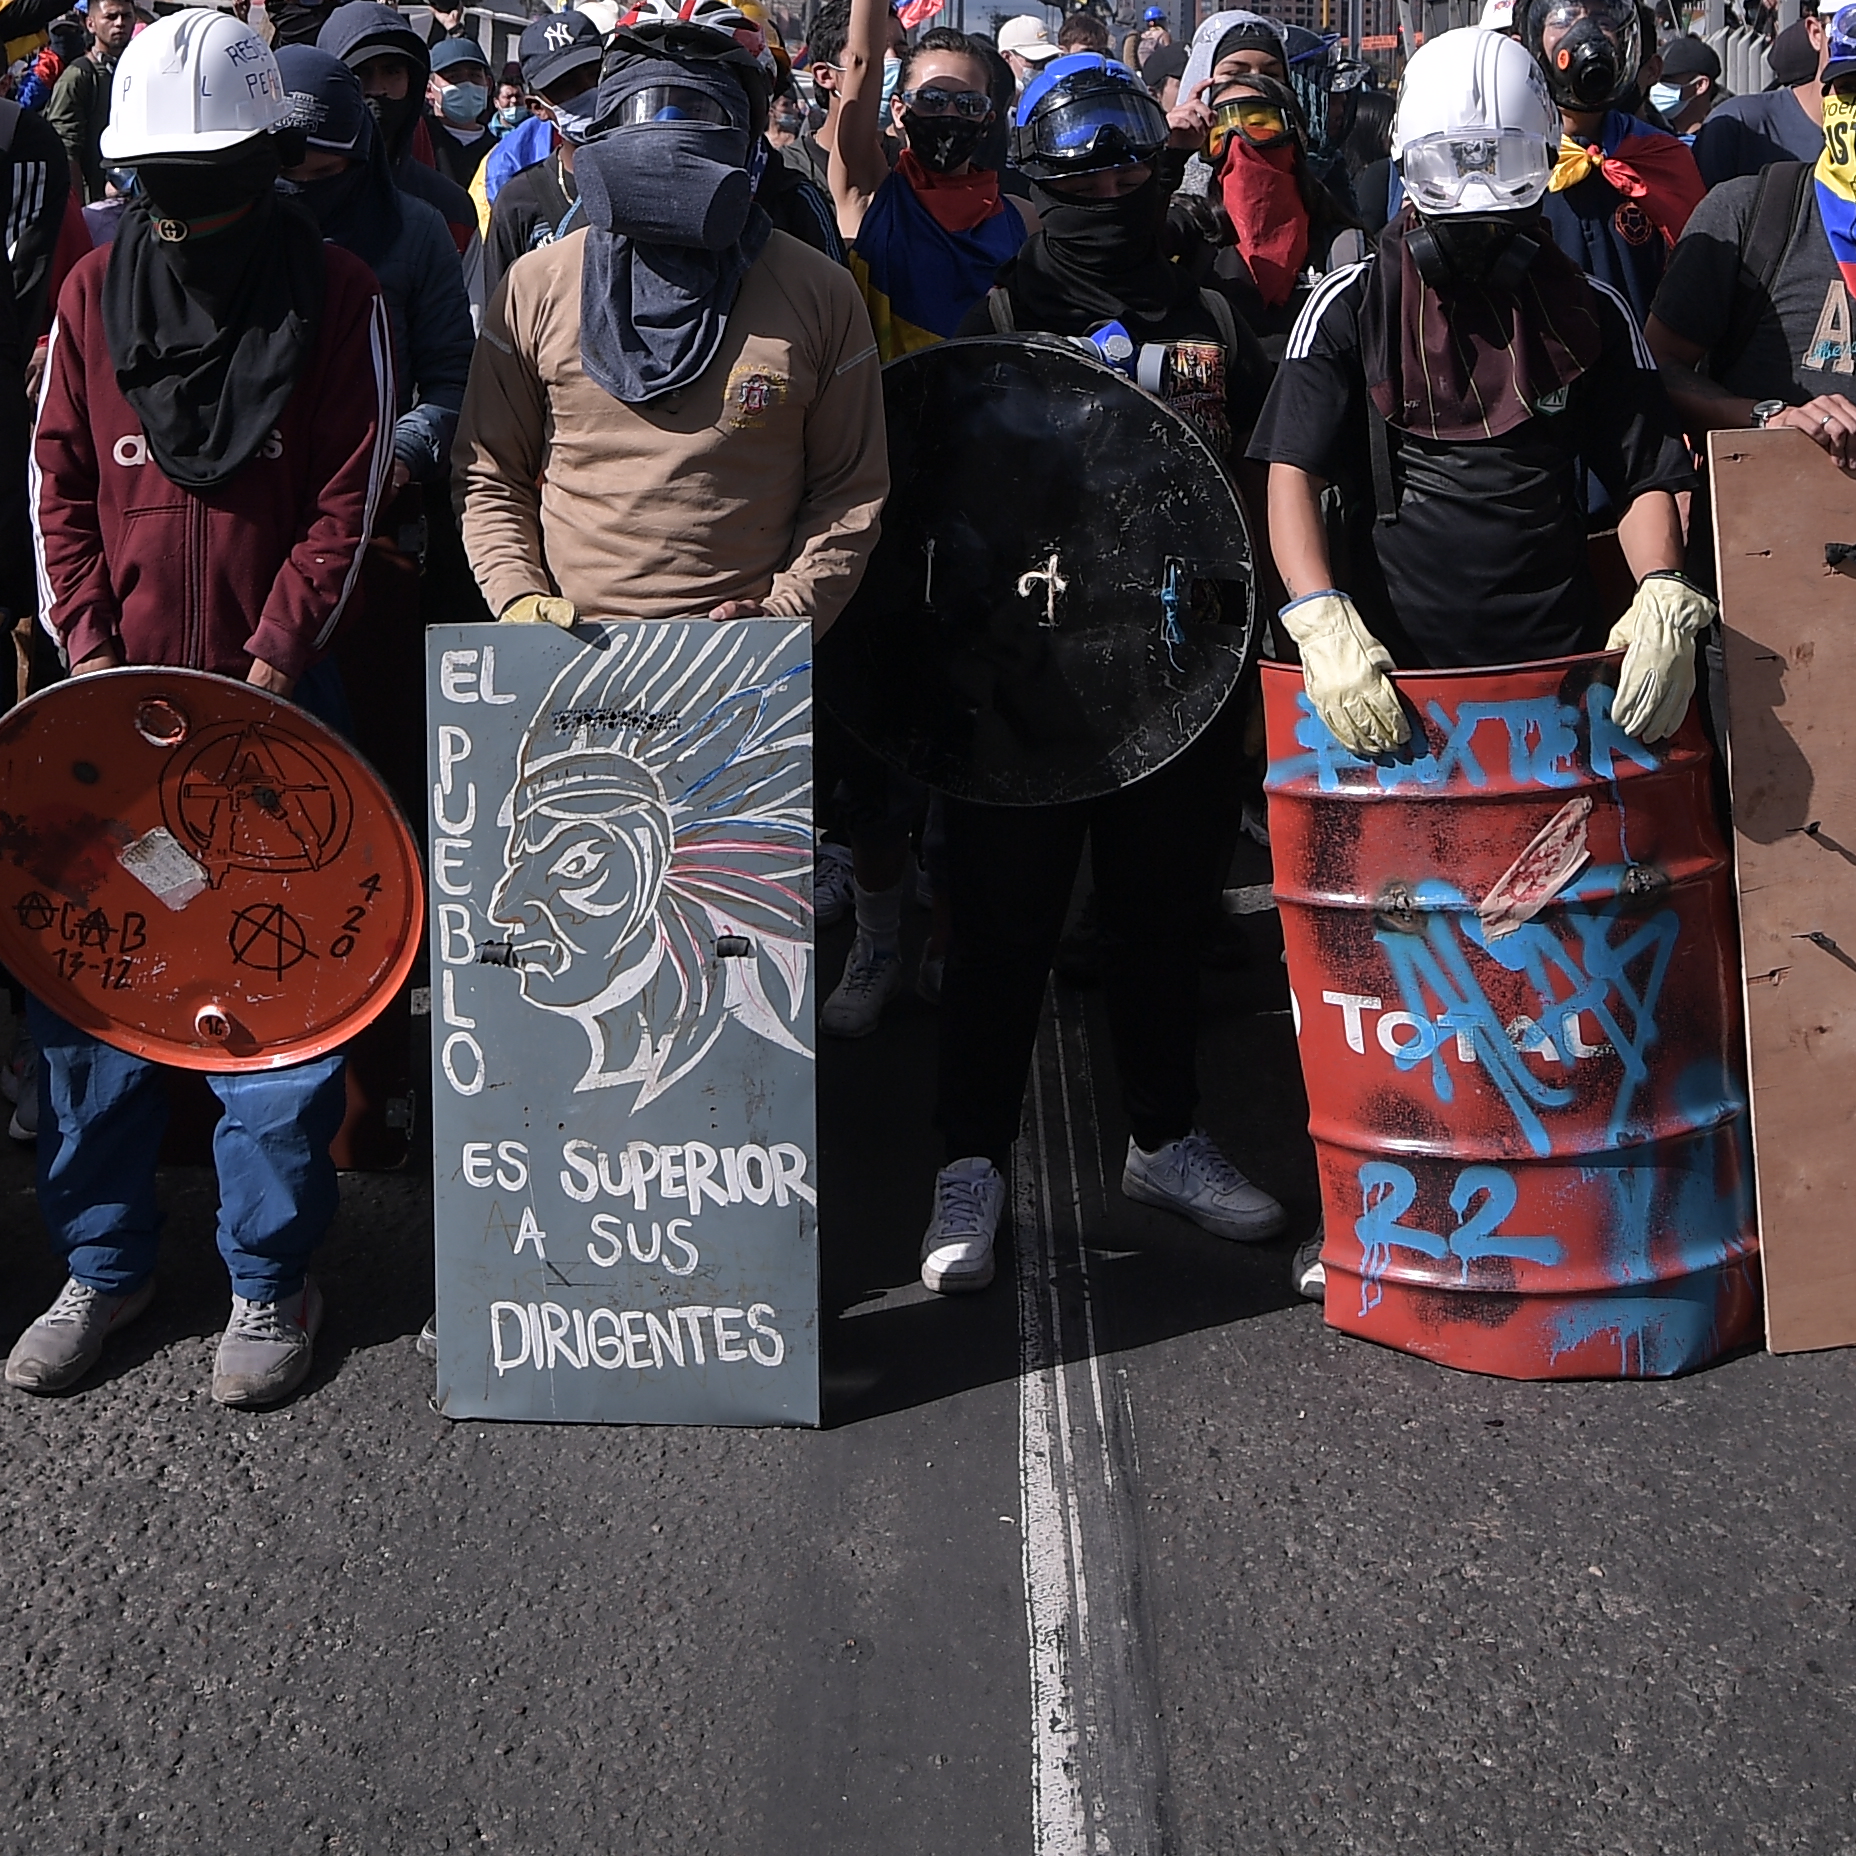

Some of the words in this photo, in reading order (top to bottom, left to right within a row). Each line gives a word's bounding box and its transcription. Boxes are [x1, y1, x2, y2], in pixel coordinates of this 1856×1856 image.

[440, 645, 517, 706] EL
[432, 744, 487, 1096] PUEBLO
[461, 1139, 530, 1193] ES
[558, 1138, 816, 1214] SUPERIOR
[511, 1204, 547, 1260] A
[585, 1213, 700, 1277] SUS
[490, 1300, 786, 1377] DIRIGENTES
